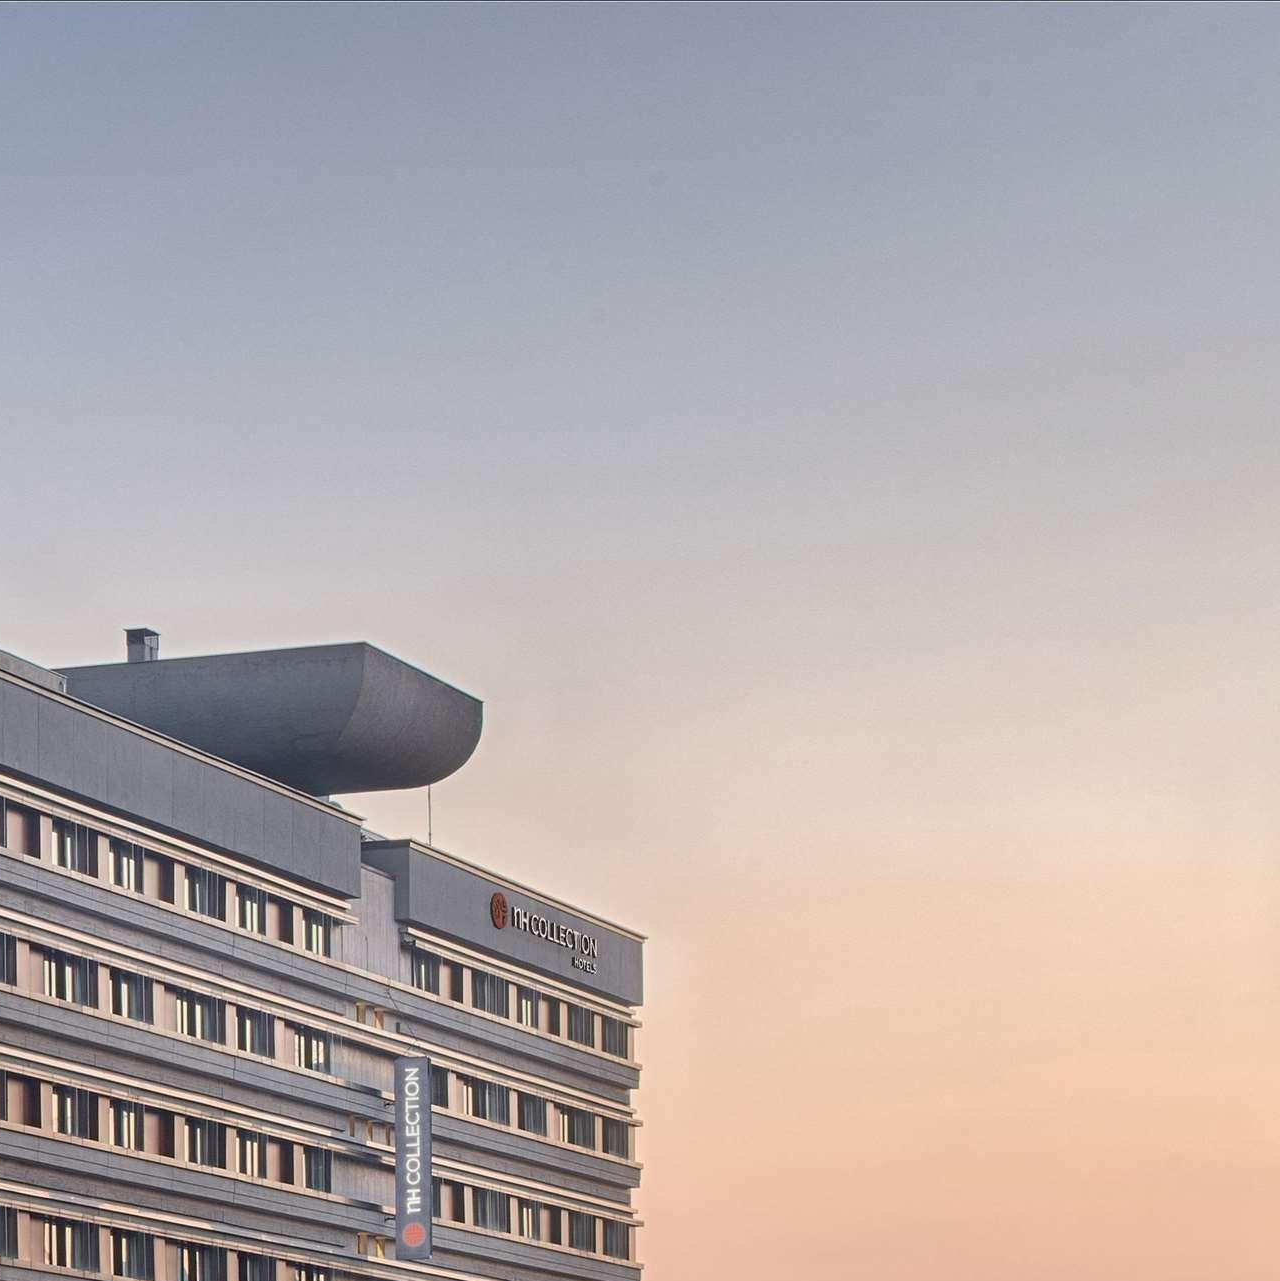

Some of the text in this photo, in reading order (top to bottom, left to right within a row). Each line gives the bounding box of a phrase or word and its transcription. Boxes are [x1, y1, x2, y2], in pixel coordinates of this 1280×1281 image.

[530, 914, 598, 957] COLLECTION
[573, 957, 598, 974] HOTELS
[404, 1067, 422, 1186] COLLECTION
